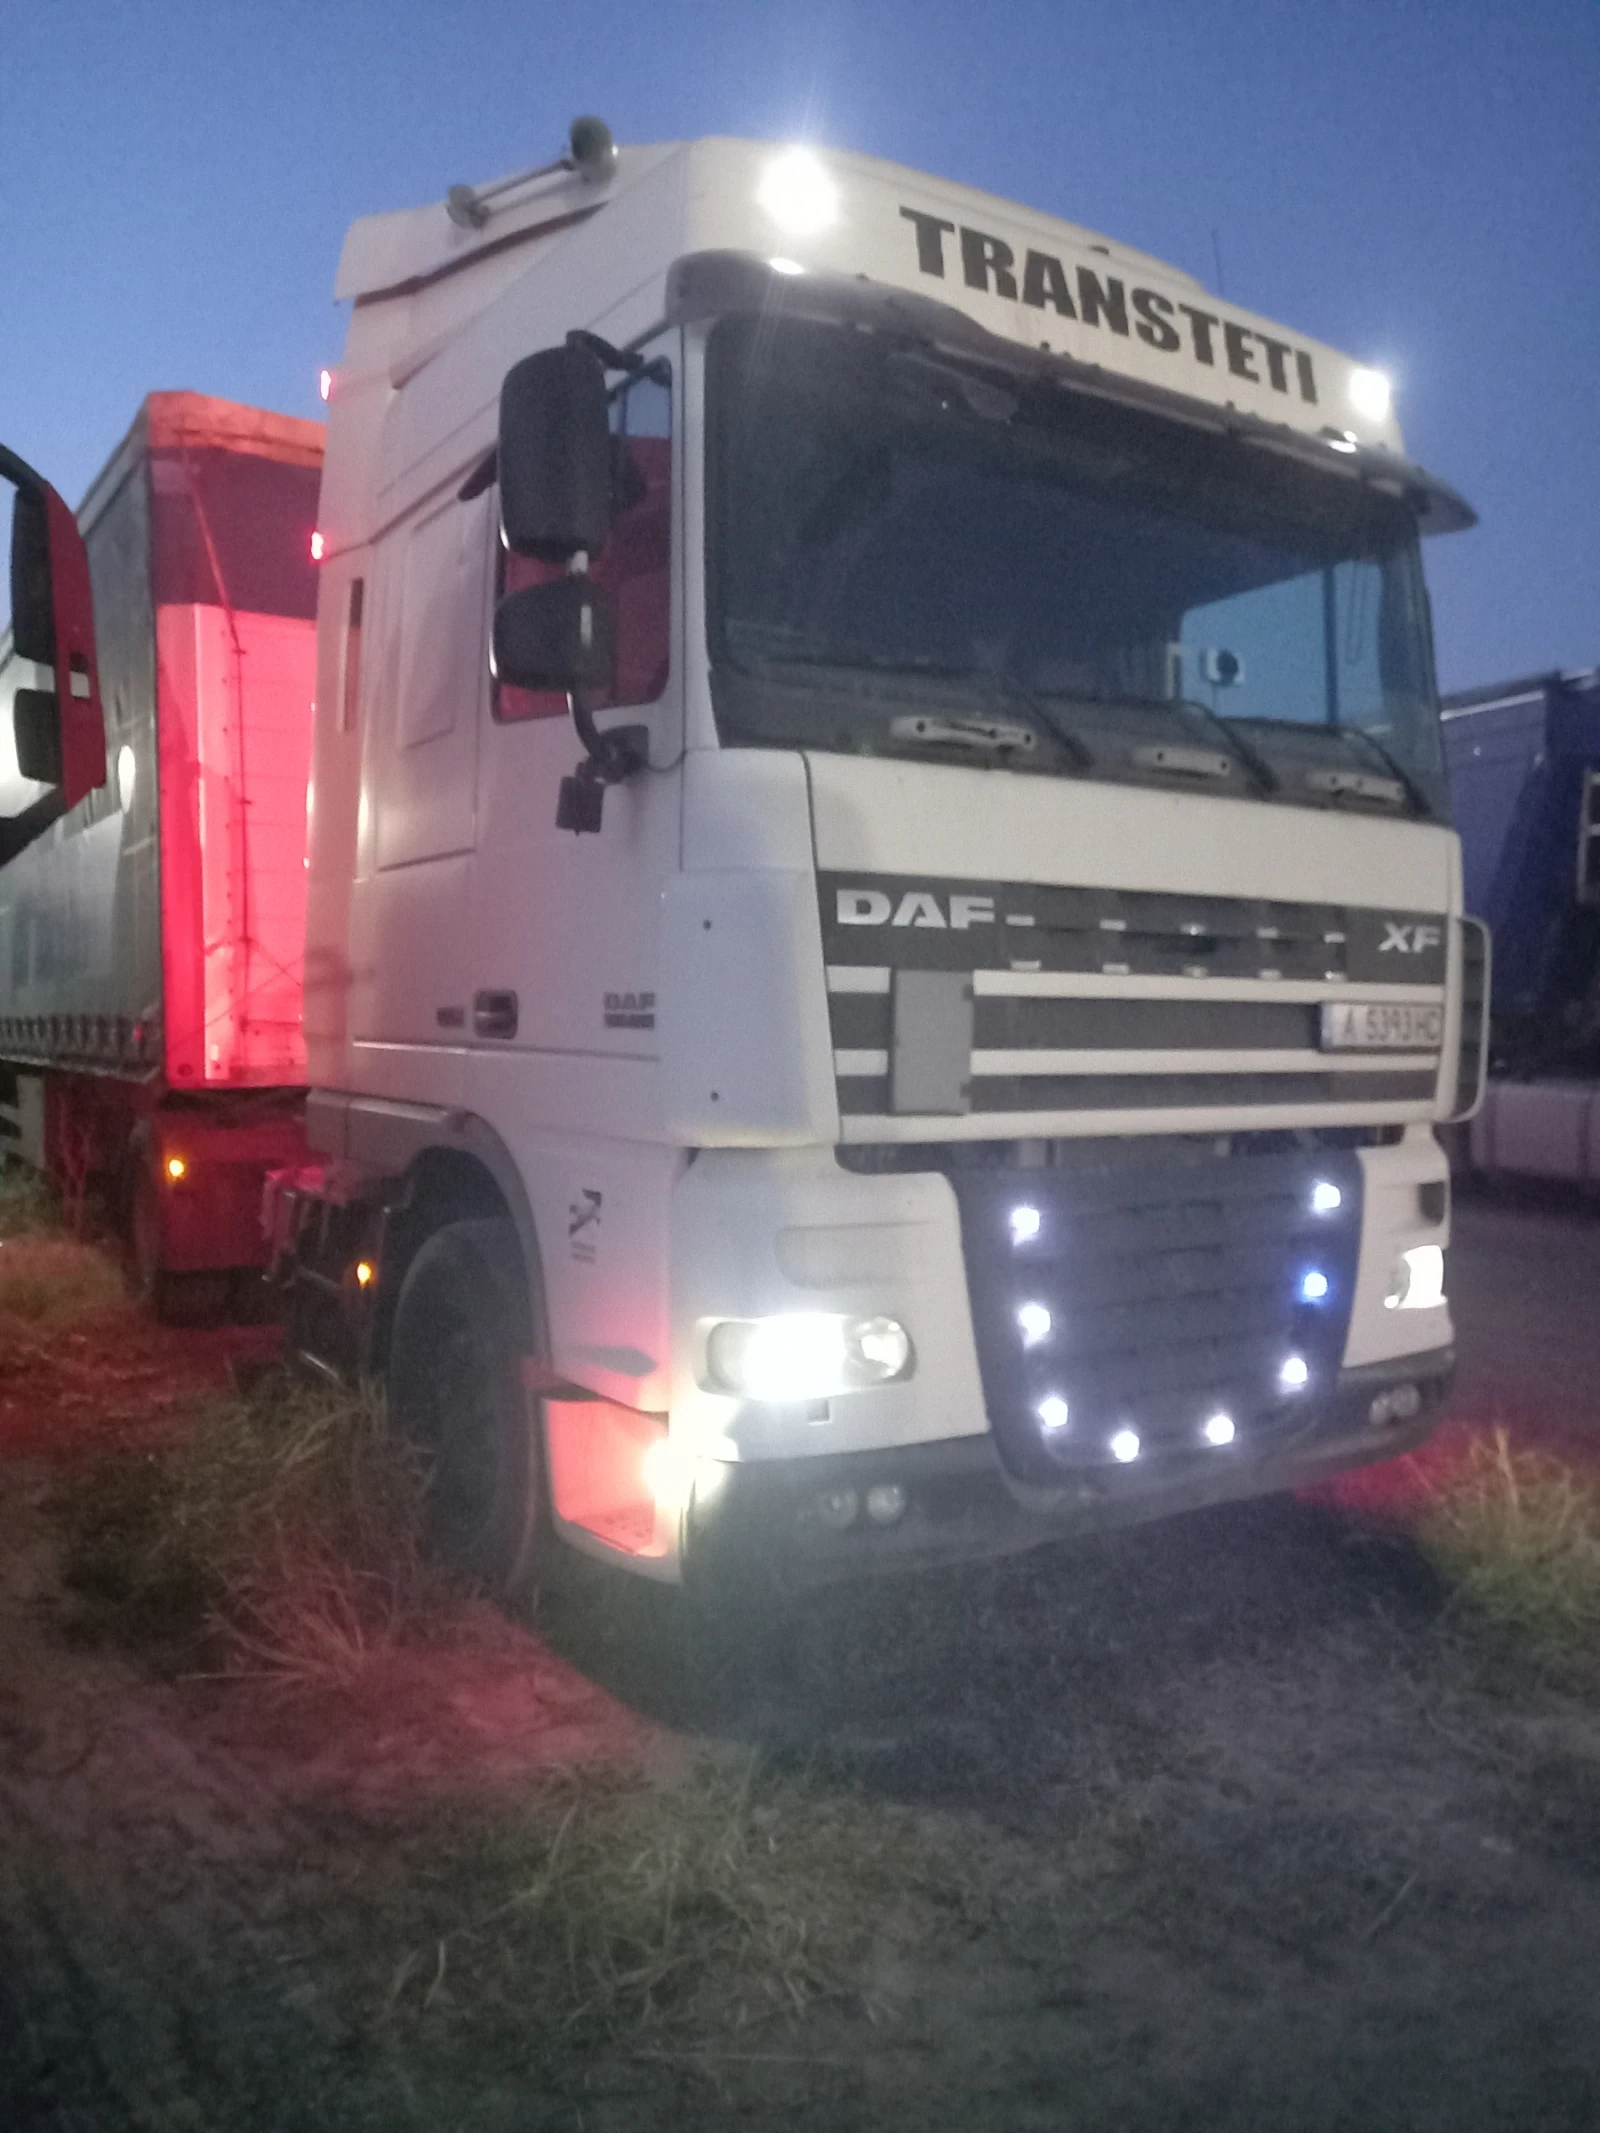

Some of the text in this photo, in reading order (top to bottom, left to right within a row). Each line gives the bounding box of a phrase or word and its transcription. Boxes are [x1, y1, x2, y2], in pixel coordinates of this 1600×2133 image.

[899, 205, 1319, 405] TRANSTETI
[836, 888, 996, 931] DAF
[1379, 920, 1442, 954] XF
